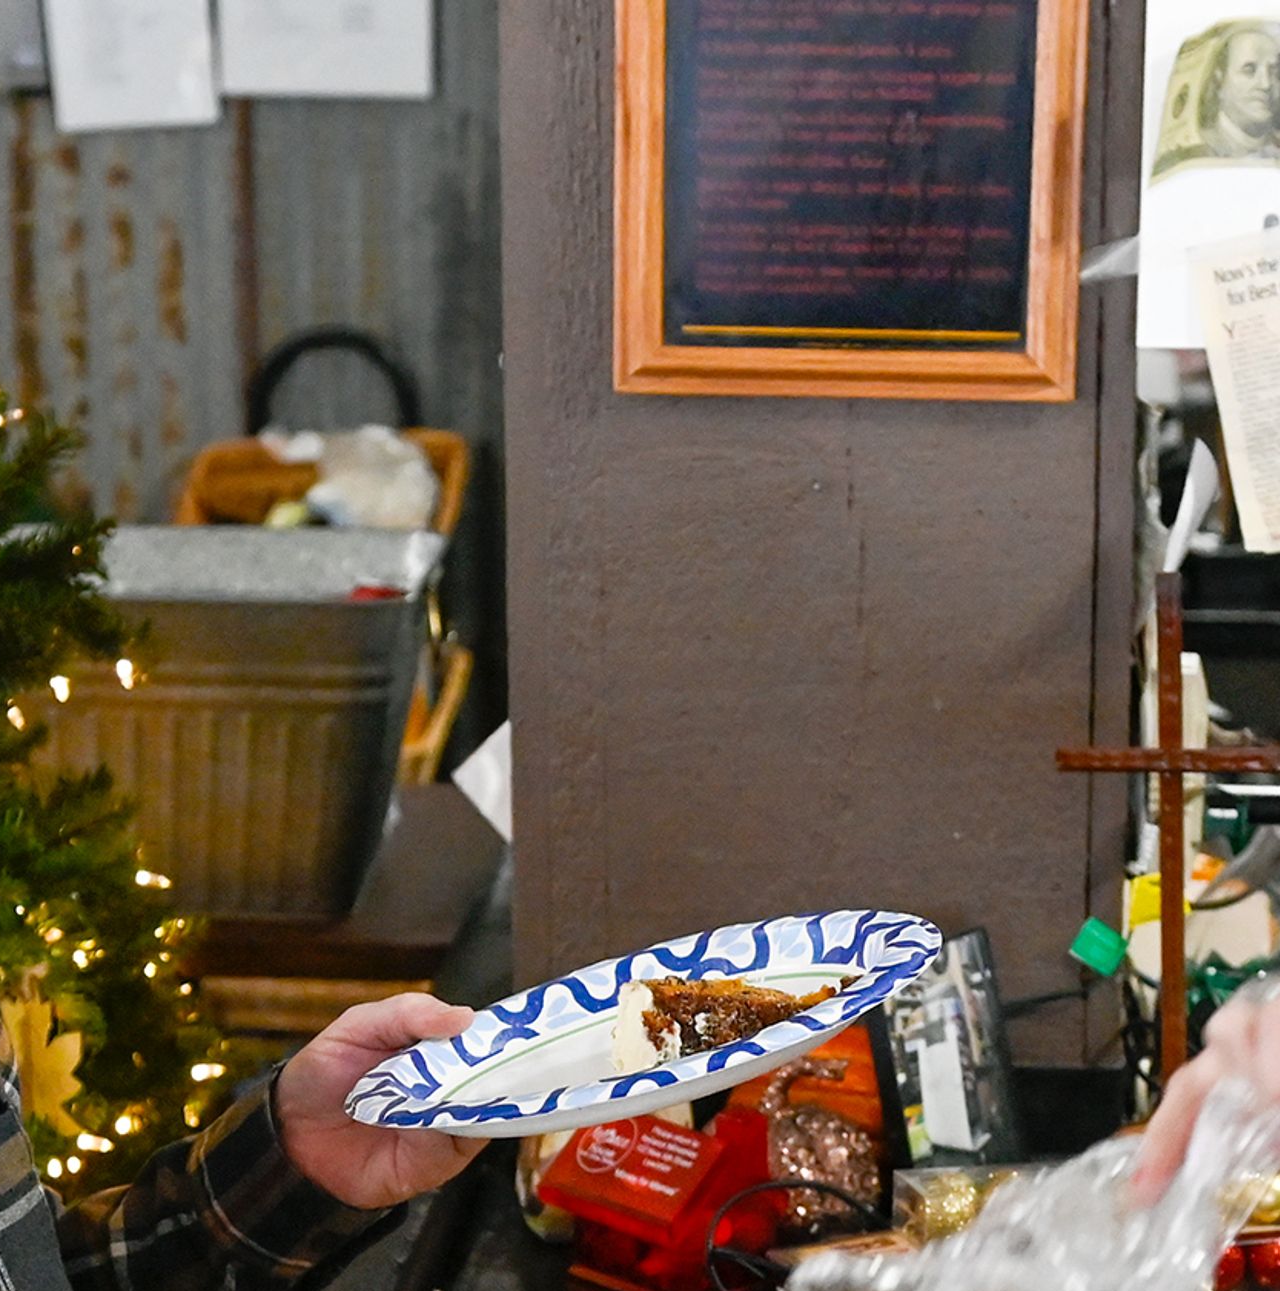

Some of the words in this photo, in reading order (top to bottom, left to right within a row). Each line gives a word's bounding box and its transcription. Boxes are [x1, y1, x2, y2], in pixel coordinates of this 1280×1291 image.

[1256, 257, 1279, 276] the
[1226, 288, 1246, 306] for
[1248, 282, 1278, 302] Best
